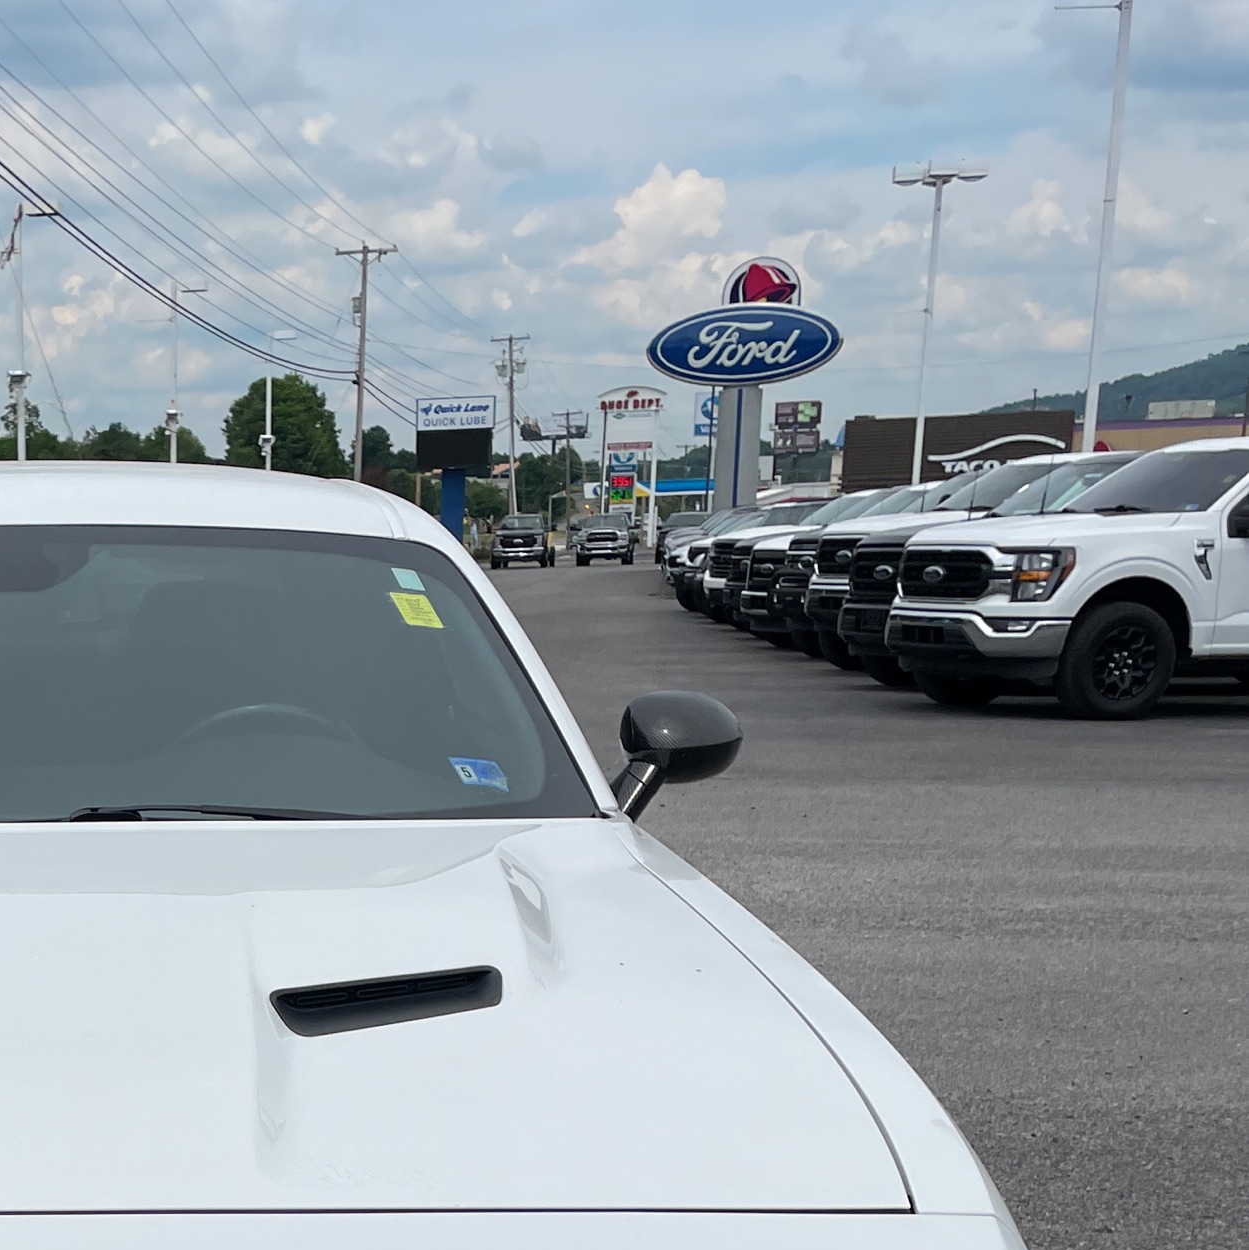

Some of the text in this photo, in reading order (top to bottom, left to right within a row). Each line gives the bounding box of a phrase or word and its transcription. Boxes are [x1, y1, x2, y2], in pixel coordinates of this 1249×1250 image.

[687, 320, 802, 369] Ford
[433, 403, 490, 415] Quick Lane
[423, 415, 487, 427] QUICK LUBE
[941, 460, 1001, 474] TACO
[460, 766, 472, 778] 5
